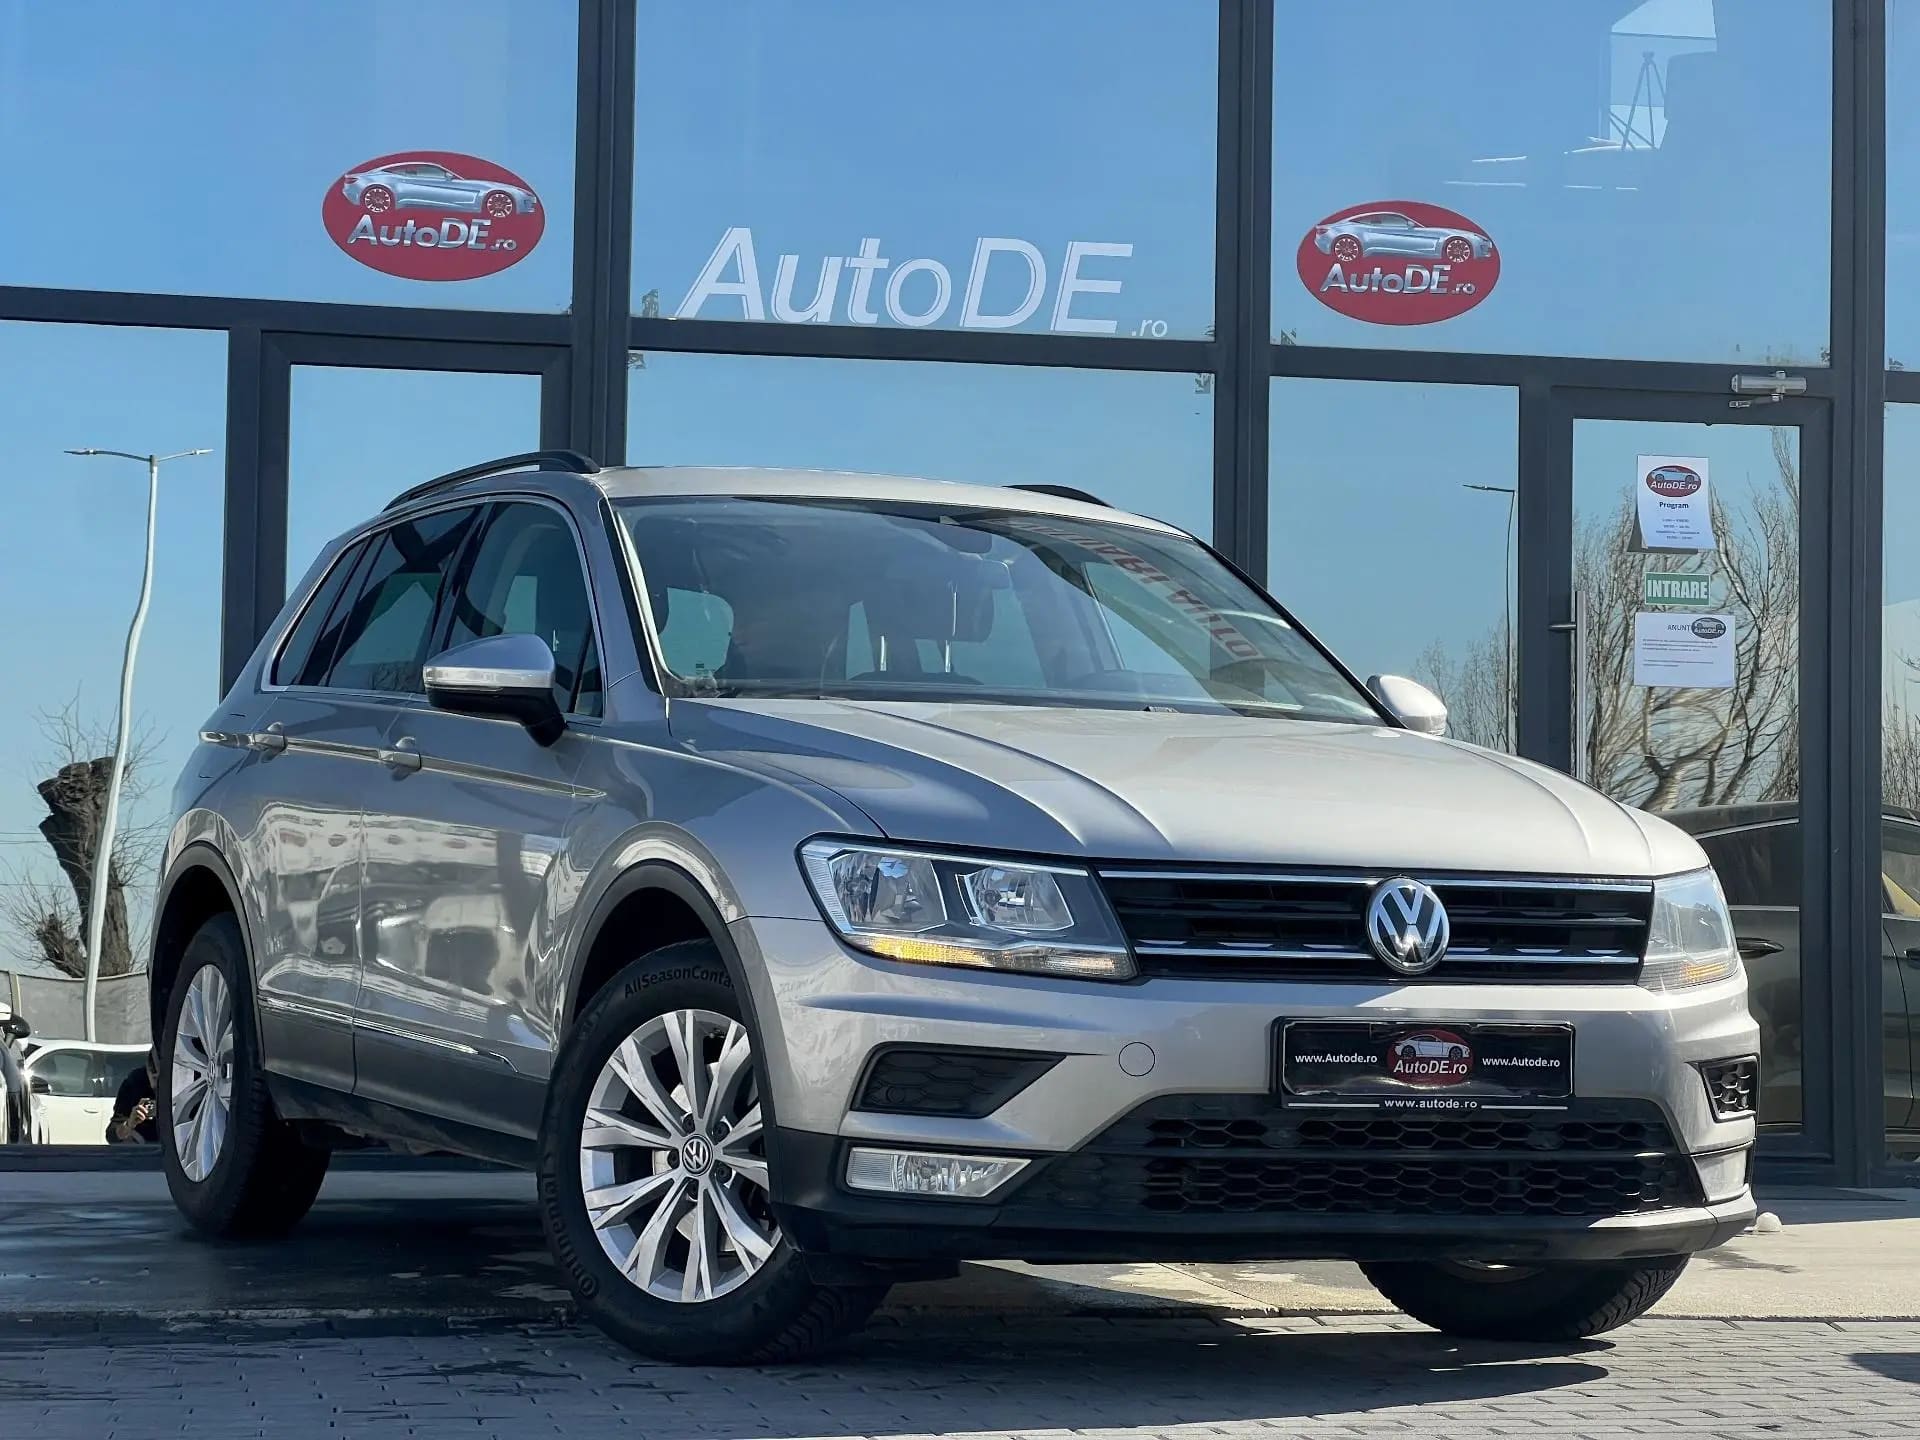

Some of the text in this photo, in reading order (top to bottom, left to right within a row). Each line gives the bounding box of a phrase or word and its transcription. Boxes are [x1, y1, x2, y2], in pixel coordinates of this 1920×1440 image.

[1650, 481, 1698, 490] AutoDE.ro
[1659, 502, 1689, 510] Program
[1647, 579, 1708, 599] INTRARE
[624, 966, 735, 999] AllSeasonConta
[1295, 1053, 1378, 1064] www.Autode.ro
[1482, 1057, 1560, 1068] www.Autode.ro
[1393, 1059, 1468, 1075] AutoDE.ro
[1384, 1098, 1478, 1109] www.autode.ro
